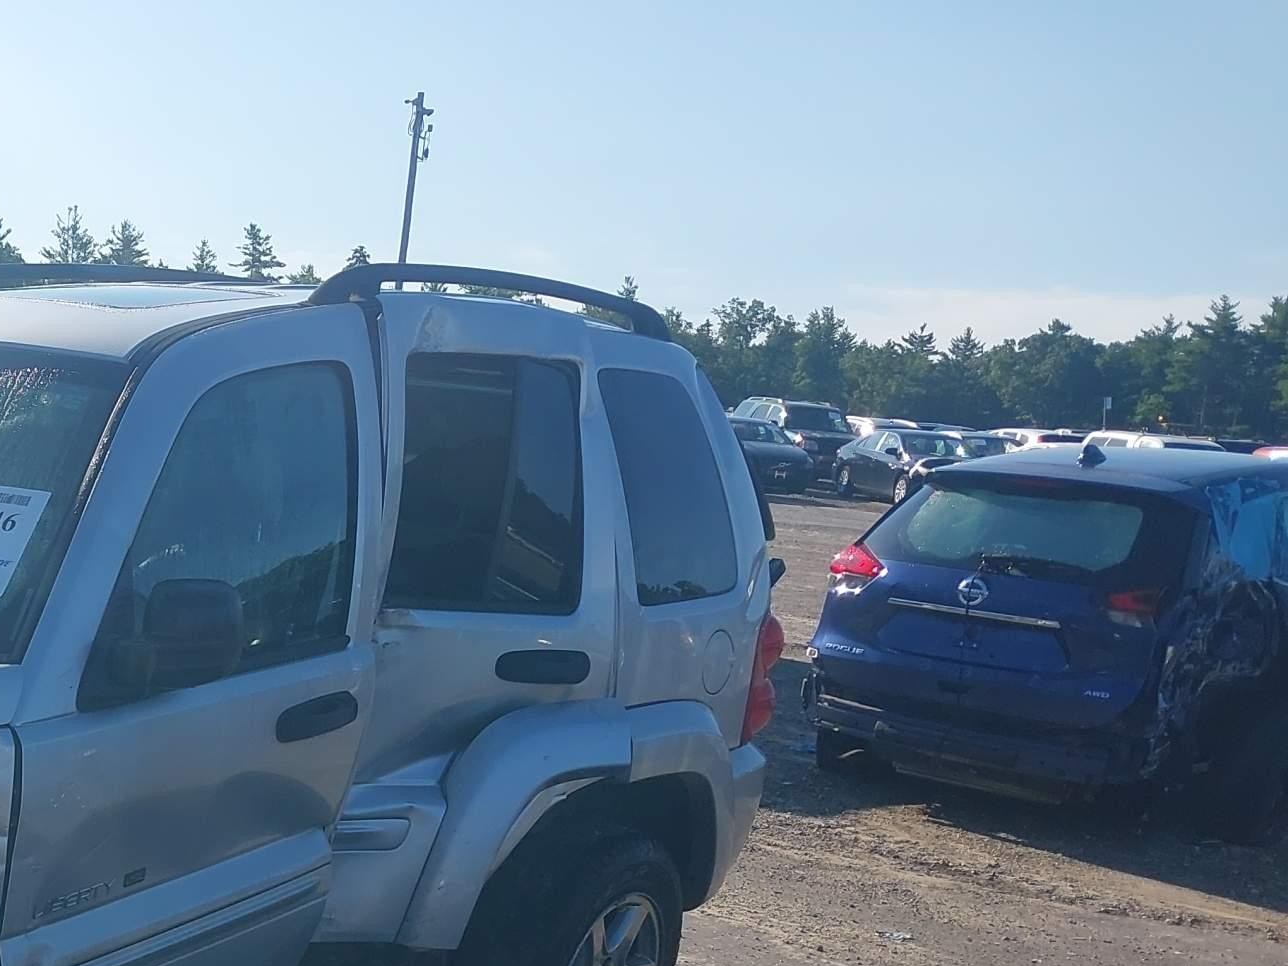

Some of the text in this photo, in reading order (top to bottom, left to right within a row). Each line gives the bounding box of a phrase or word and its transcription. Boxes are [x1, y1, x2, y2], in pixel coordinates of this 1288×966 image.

[825, 642, 865, 655] ROGUE
[1080, 686, 1110, 698] AWD
[32, 879, 114, 919] LIBERTY
